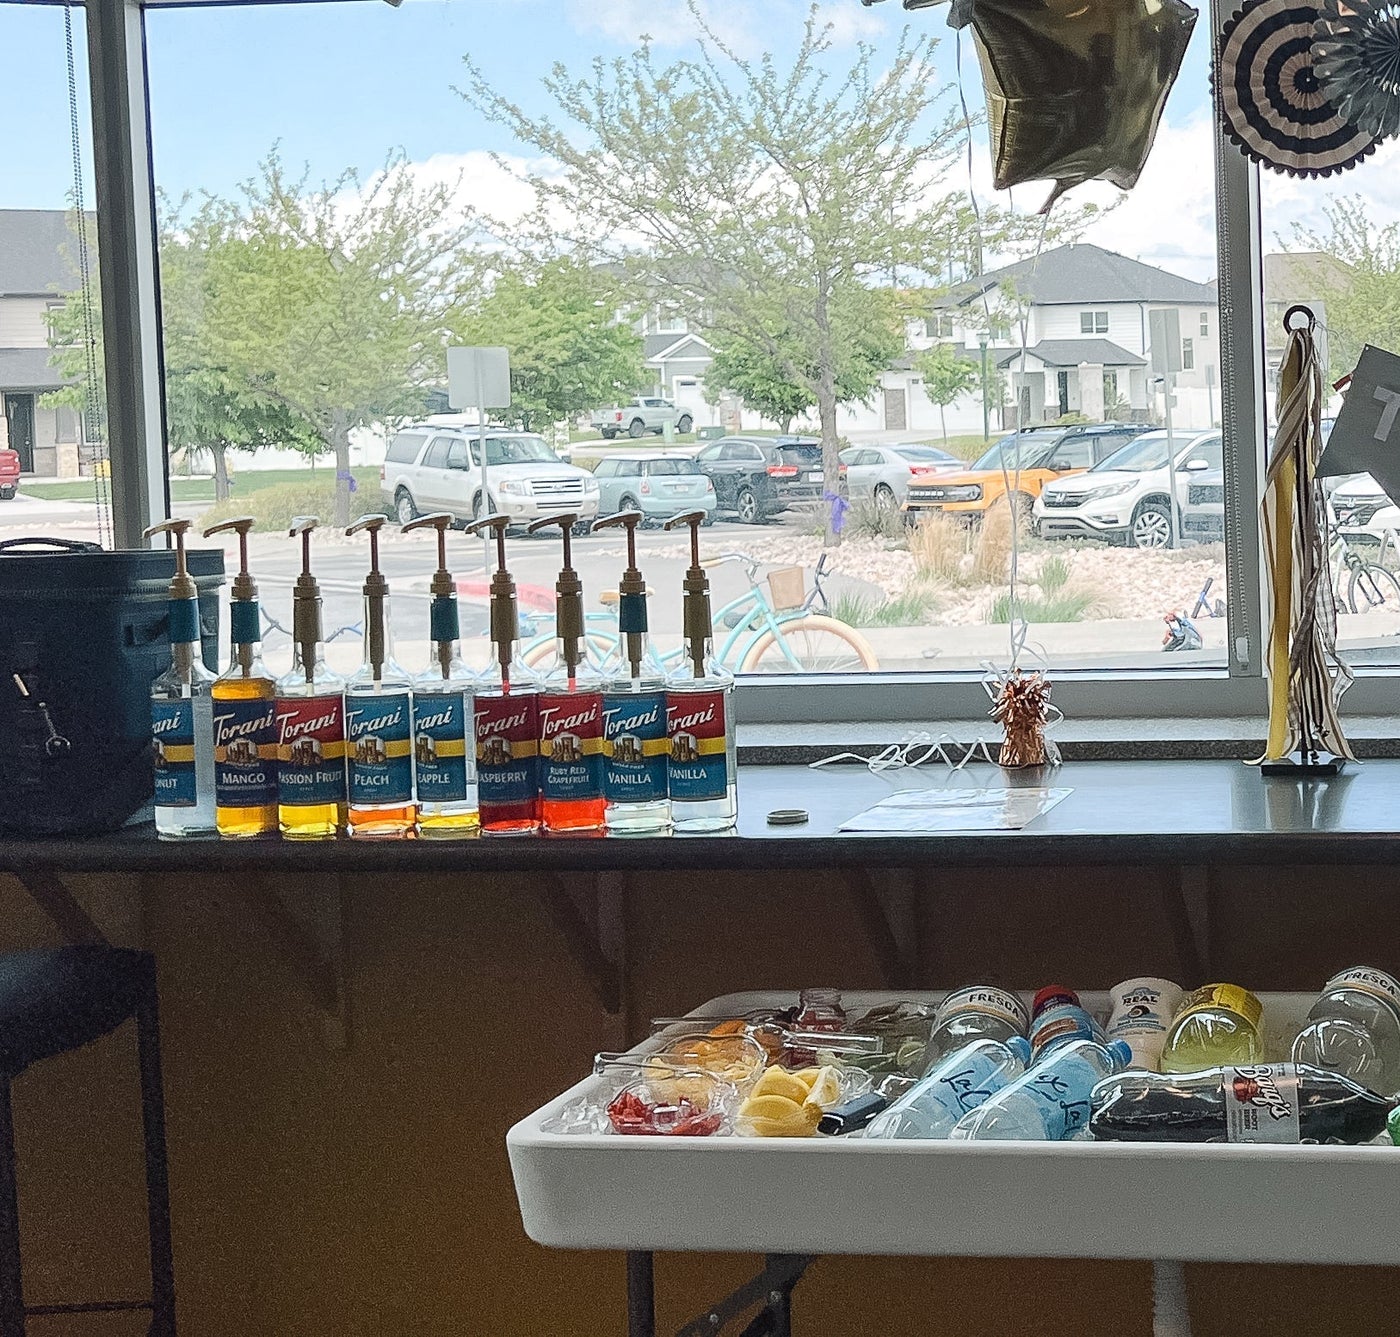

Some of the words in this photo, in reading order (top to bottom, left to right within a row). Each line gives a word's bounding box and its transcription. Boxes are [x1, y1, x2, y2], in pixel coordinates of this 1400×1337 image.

[214, 709, 273, 747] Torani
[276, 706, 337, 746] Torani
[346, 706, 402, 743] Torani
[473, 706, 528, 742] Torani
[540, 703, 598, 741] Torani
[602, 705, 658, 741] Torani
[222, 772, 266, 784] MANGO
[316, 770, 342, 783] FRUIT
[354, 774, 389, 786] PEACH
[547, 774, 590, 784] GRAPEFRUIT
[549, 766, 568, 775] RUBY
[570, 766, 586, 775] RED
[608, 771, 652, 784] VANILLA
[1343, 972, 1396, 995] FRESCA
[969, 993, 1019, 1018] FRESCA
[1122, 995, 1158, 1005] REAL
[1250, 1108, 1258, 1130] ROOT
